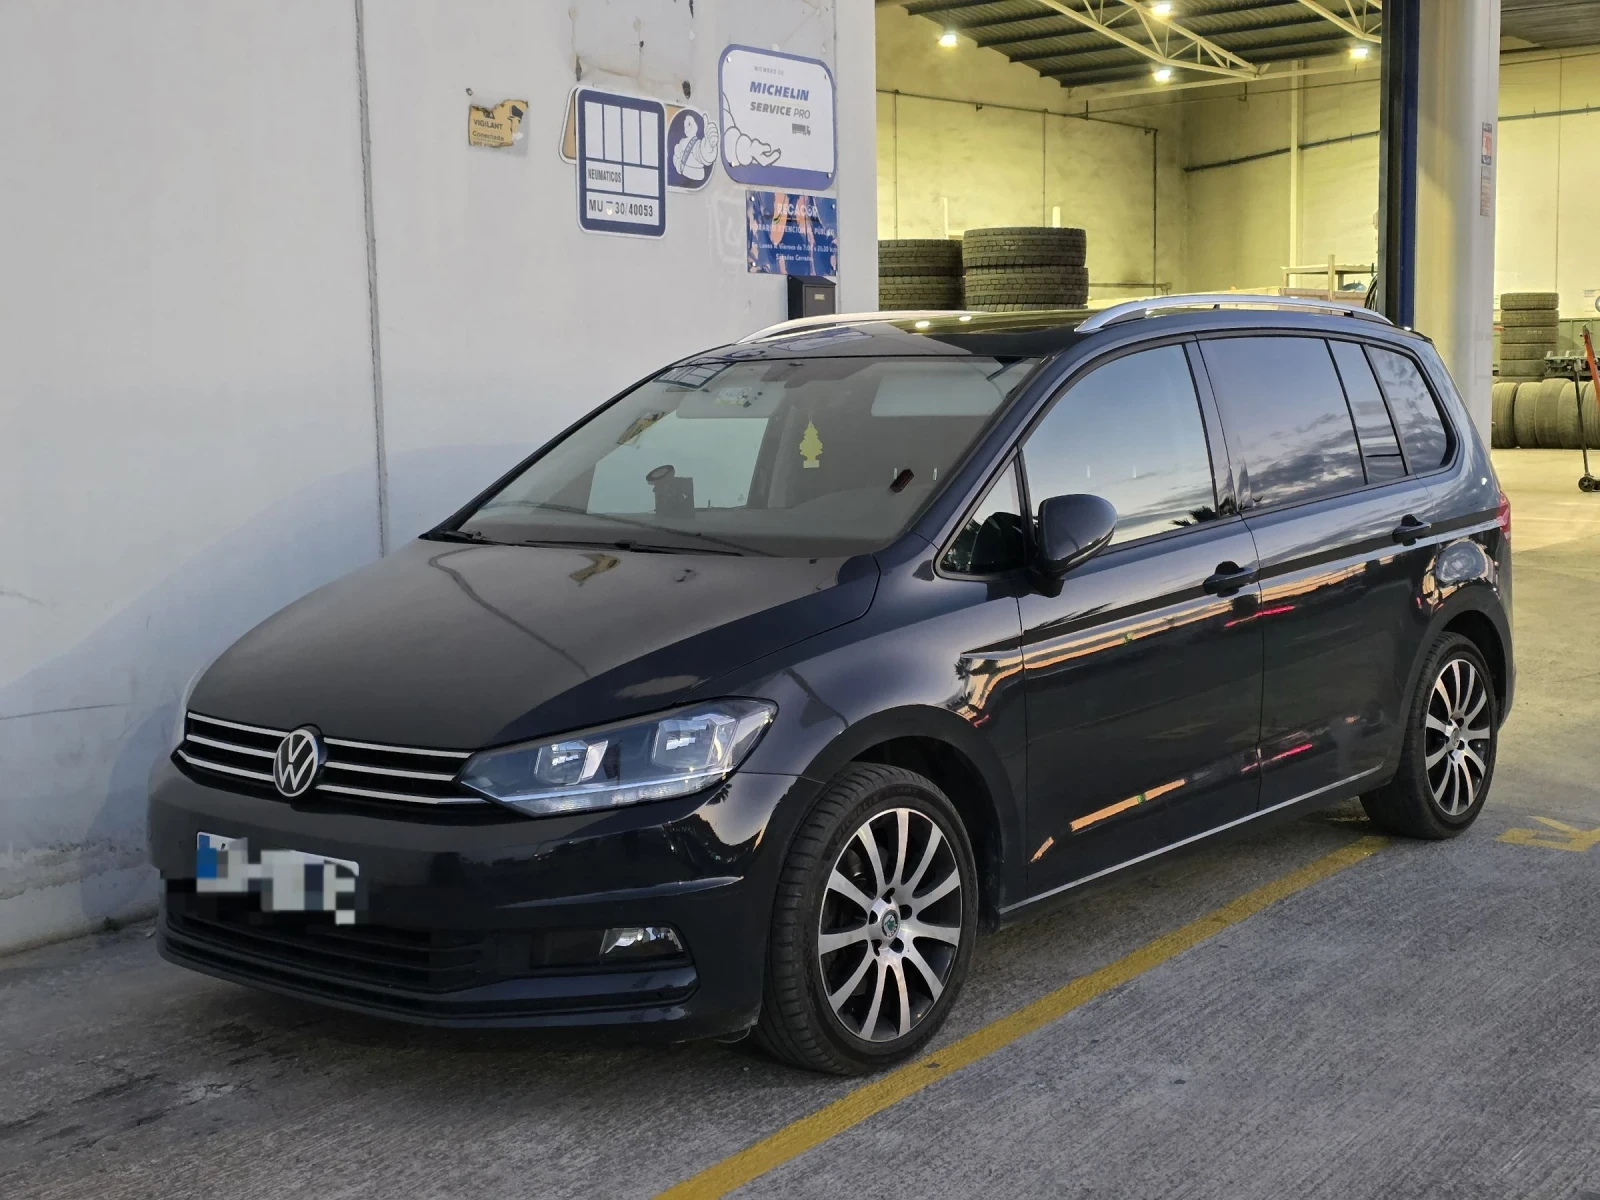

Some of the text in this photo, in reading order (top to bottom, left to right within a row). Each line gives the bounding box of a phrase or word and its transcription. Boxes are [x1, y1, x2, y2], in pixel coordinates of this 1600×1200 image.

[749, 81, 810, 101] MICHELIN
[750, 101, 811, 119] SERVICE PRO
[473, 118, 503, 130] VIGILANT
[587, 168, 622, 183] NEUMATICOS
[588, 199, 604, 213] MU
